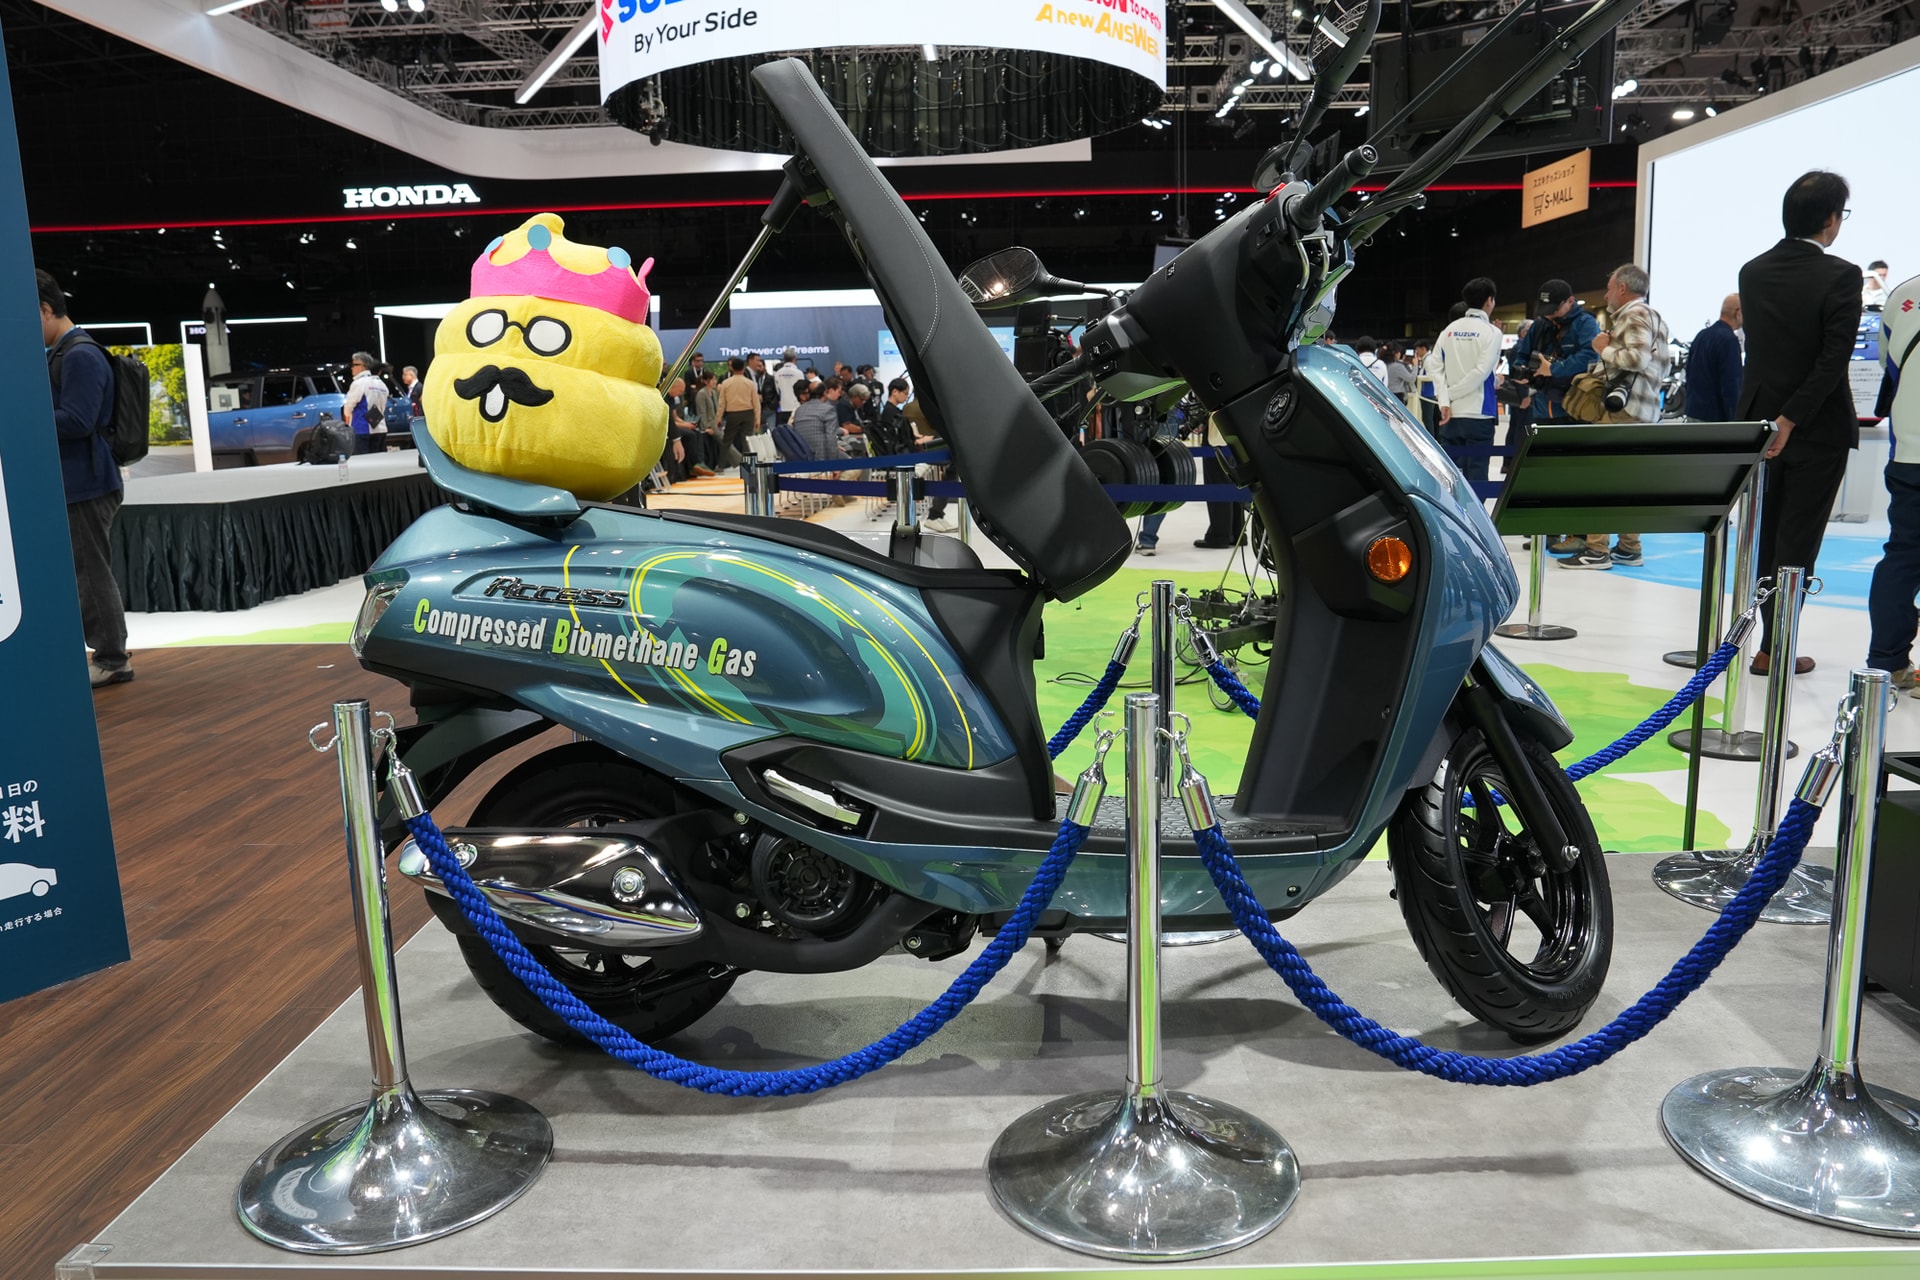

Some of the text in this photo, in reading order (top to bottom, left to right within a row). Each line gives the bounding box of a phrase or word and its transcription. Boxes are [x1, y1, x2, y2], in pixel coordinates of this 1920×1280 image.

[1035, 3, 1053, 24] A
[1056, 9, 1095, 29] new
[634, 34, 653, 54] By
[656, 20, 701, 44] Your
[705, 8, 758, 32] Side
[343, 183, 481, 208] HONDA
[1544, 186, 1574, 209] S-MALL
[720, 347, 739, 356] The
[741, 346, 775, 356] Power
[788, 345, 830, 354] Dreams
[413, 598, 757, 677] Compressed Biomethane Gas
[2, 800, 46, 843] 料
